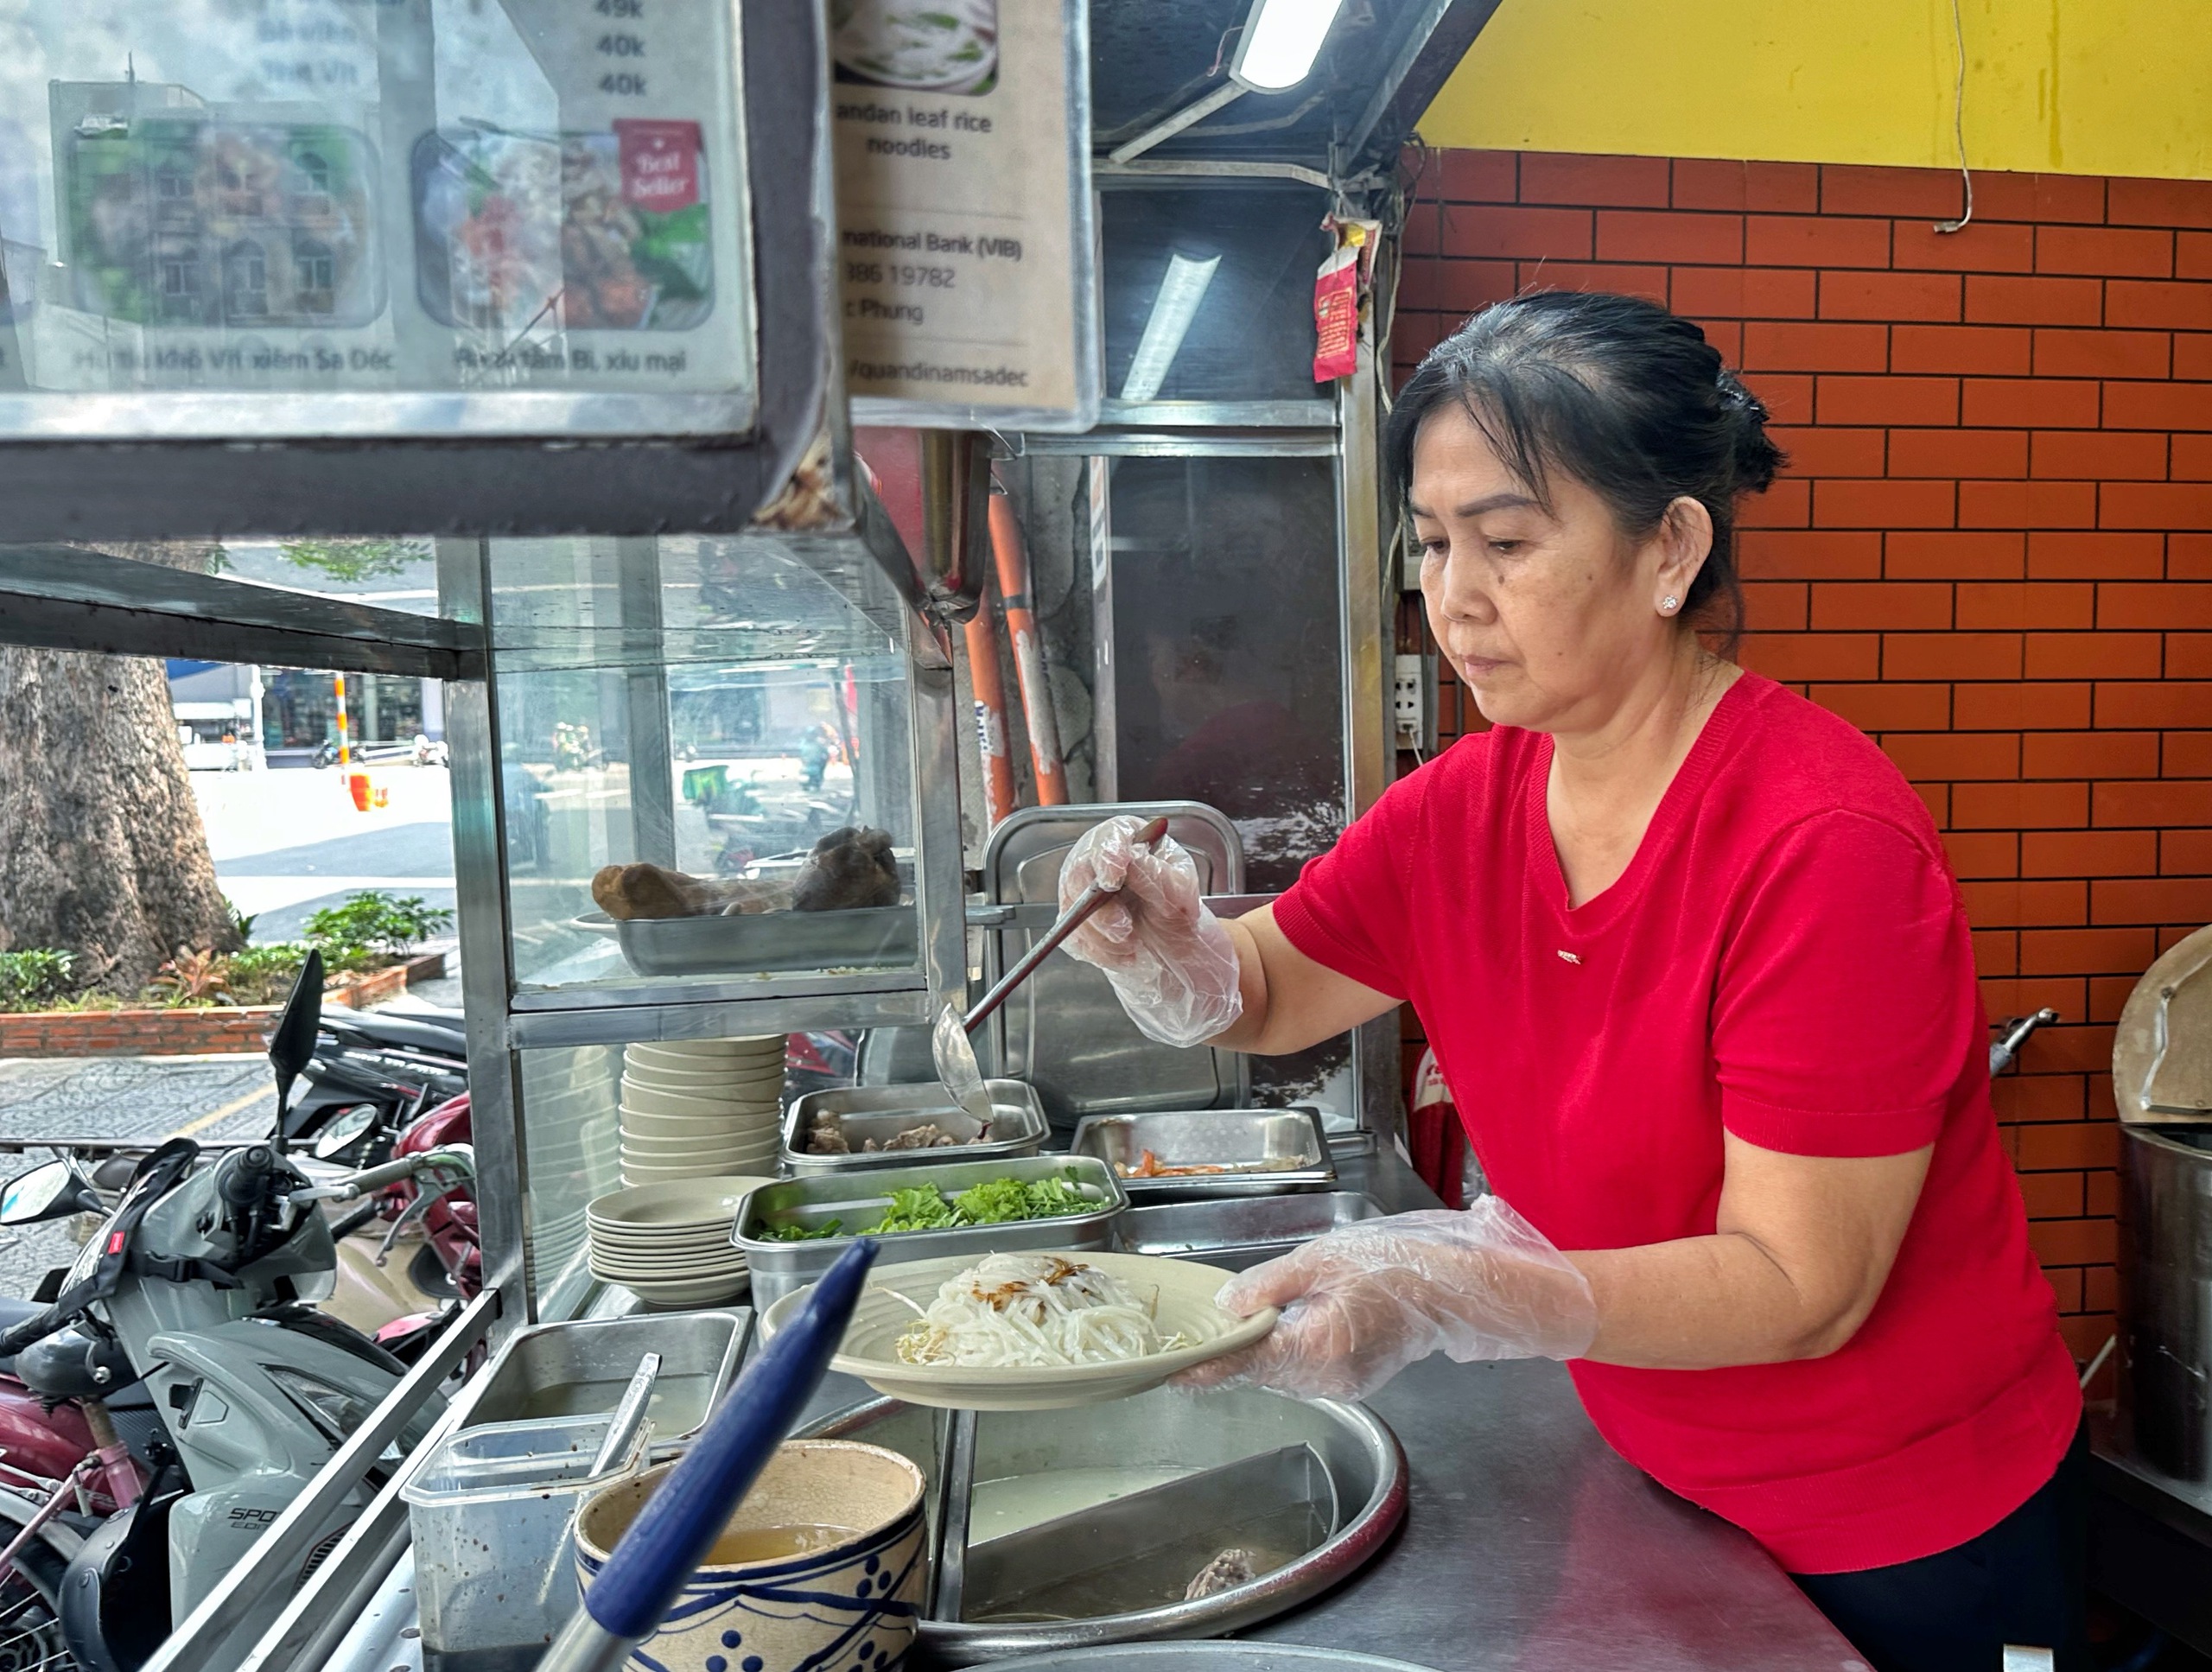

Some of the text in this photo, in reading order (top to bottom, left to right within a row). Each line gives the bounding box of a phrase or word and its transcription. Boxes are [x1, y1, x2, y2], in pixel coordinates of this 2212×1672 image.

[596, 35, 645, 57] 40k
[598, 73, 645, 95] 40k
[908, 107, 948, 129] leaf
[953, 113, 992, 132] rice
[868, 137, 951, 160] noodles
[926, 233, 973, 254] Bank
[977, 237, 1022, 261] (VIB)
[891, 265, 957, 289] 19782
[861, 299, 924, 325] Phung
